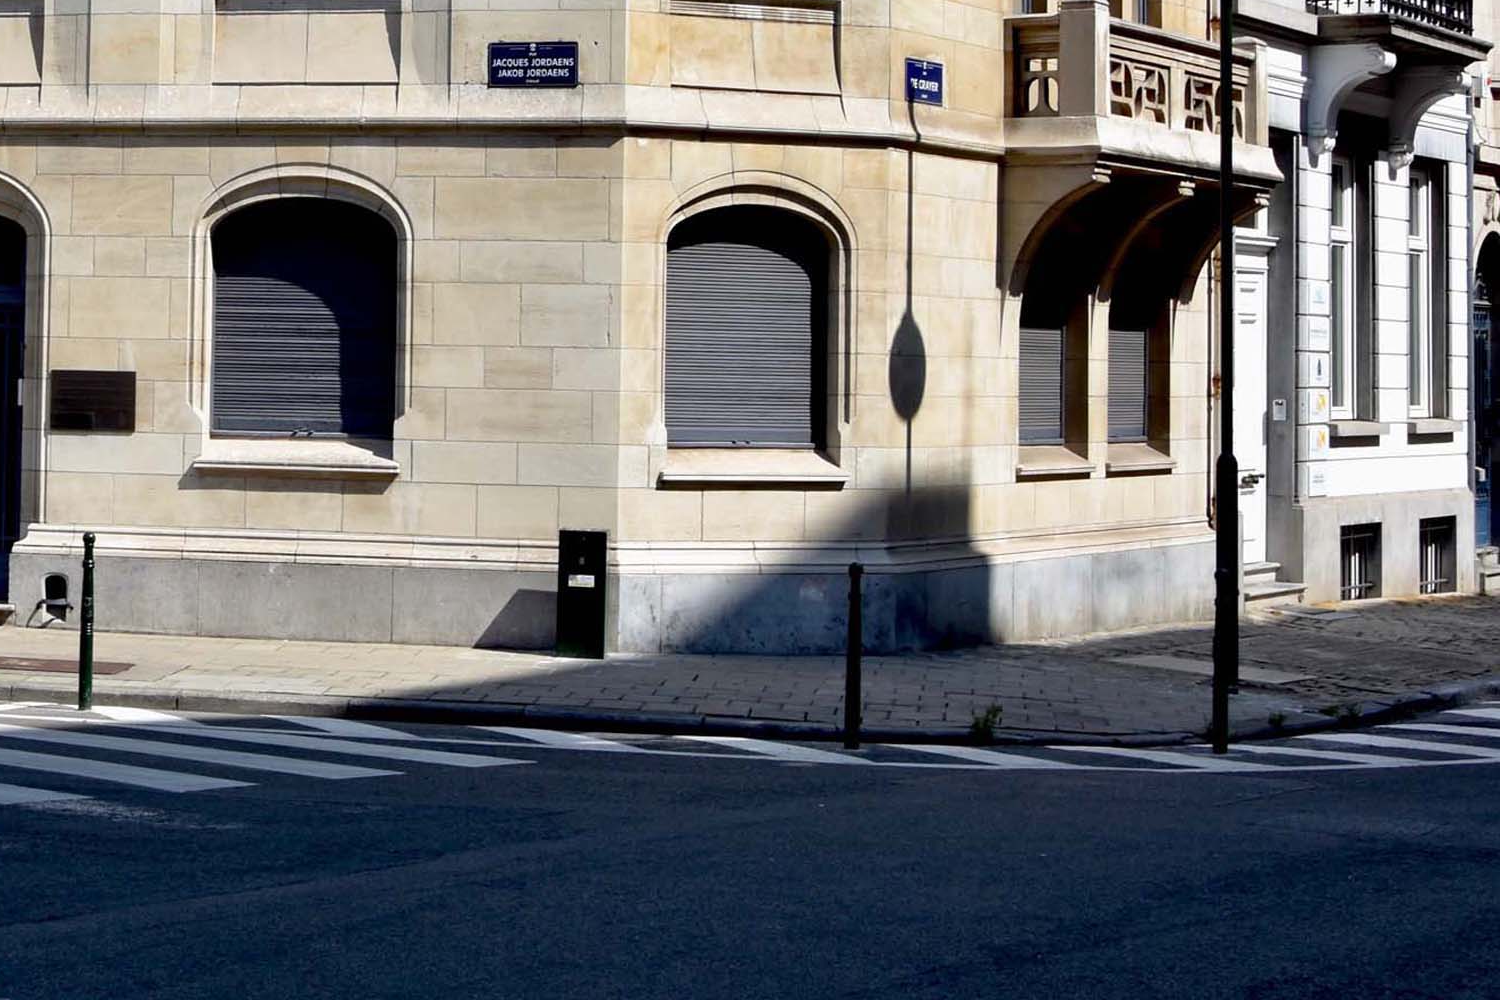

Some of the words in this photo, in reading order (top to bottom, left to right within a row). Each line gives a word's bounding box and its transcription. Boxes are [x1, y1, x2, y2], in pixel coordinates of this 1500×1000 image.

[492, 58, 529, 67] JACQUES
[531, 57, 574, 67] JORDAENS
[498, 69, 524, 78] JAKOB
[526, 68, 569, 77] JORDAENS
